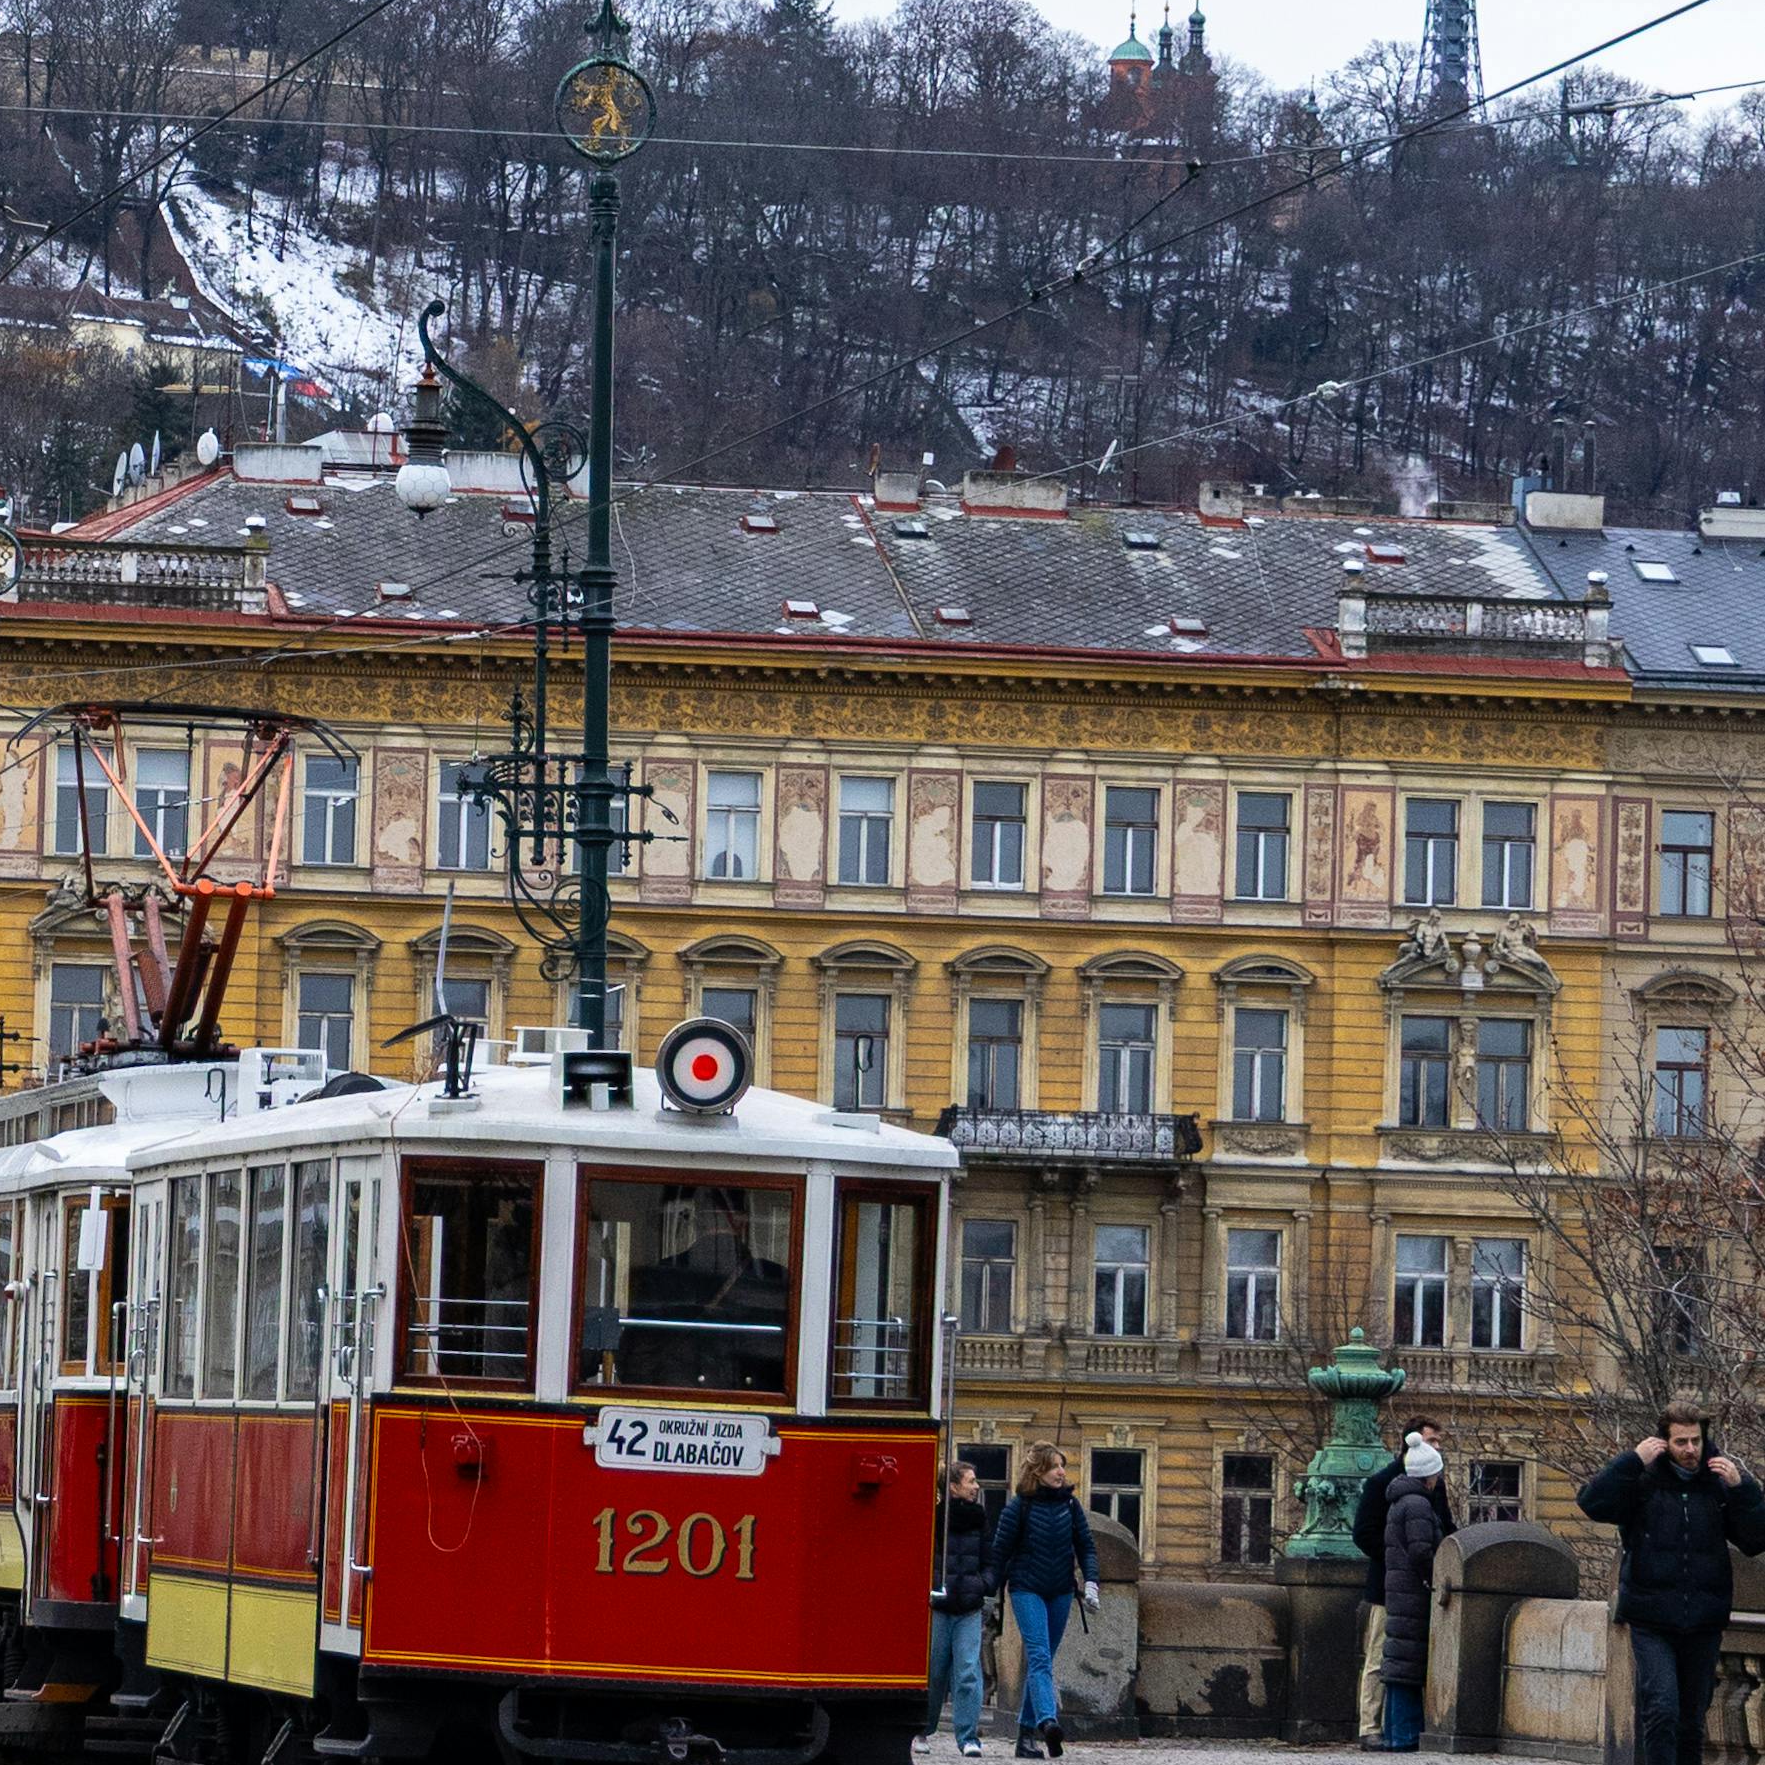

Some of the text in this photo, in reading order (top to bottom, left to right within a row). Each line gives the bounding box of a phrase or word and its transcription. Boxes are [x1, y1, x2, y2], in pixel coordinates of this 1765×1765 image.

[606, 1418, 649, 1457] 42
[659, 1419, 743, 1439] OKRUŽNÍ JÍZDA
[652, 1440, 745, 1467] DLABAČOV
[592, 1507, 756, 1580] 1201
